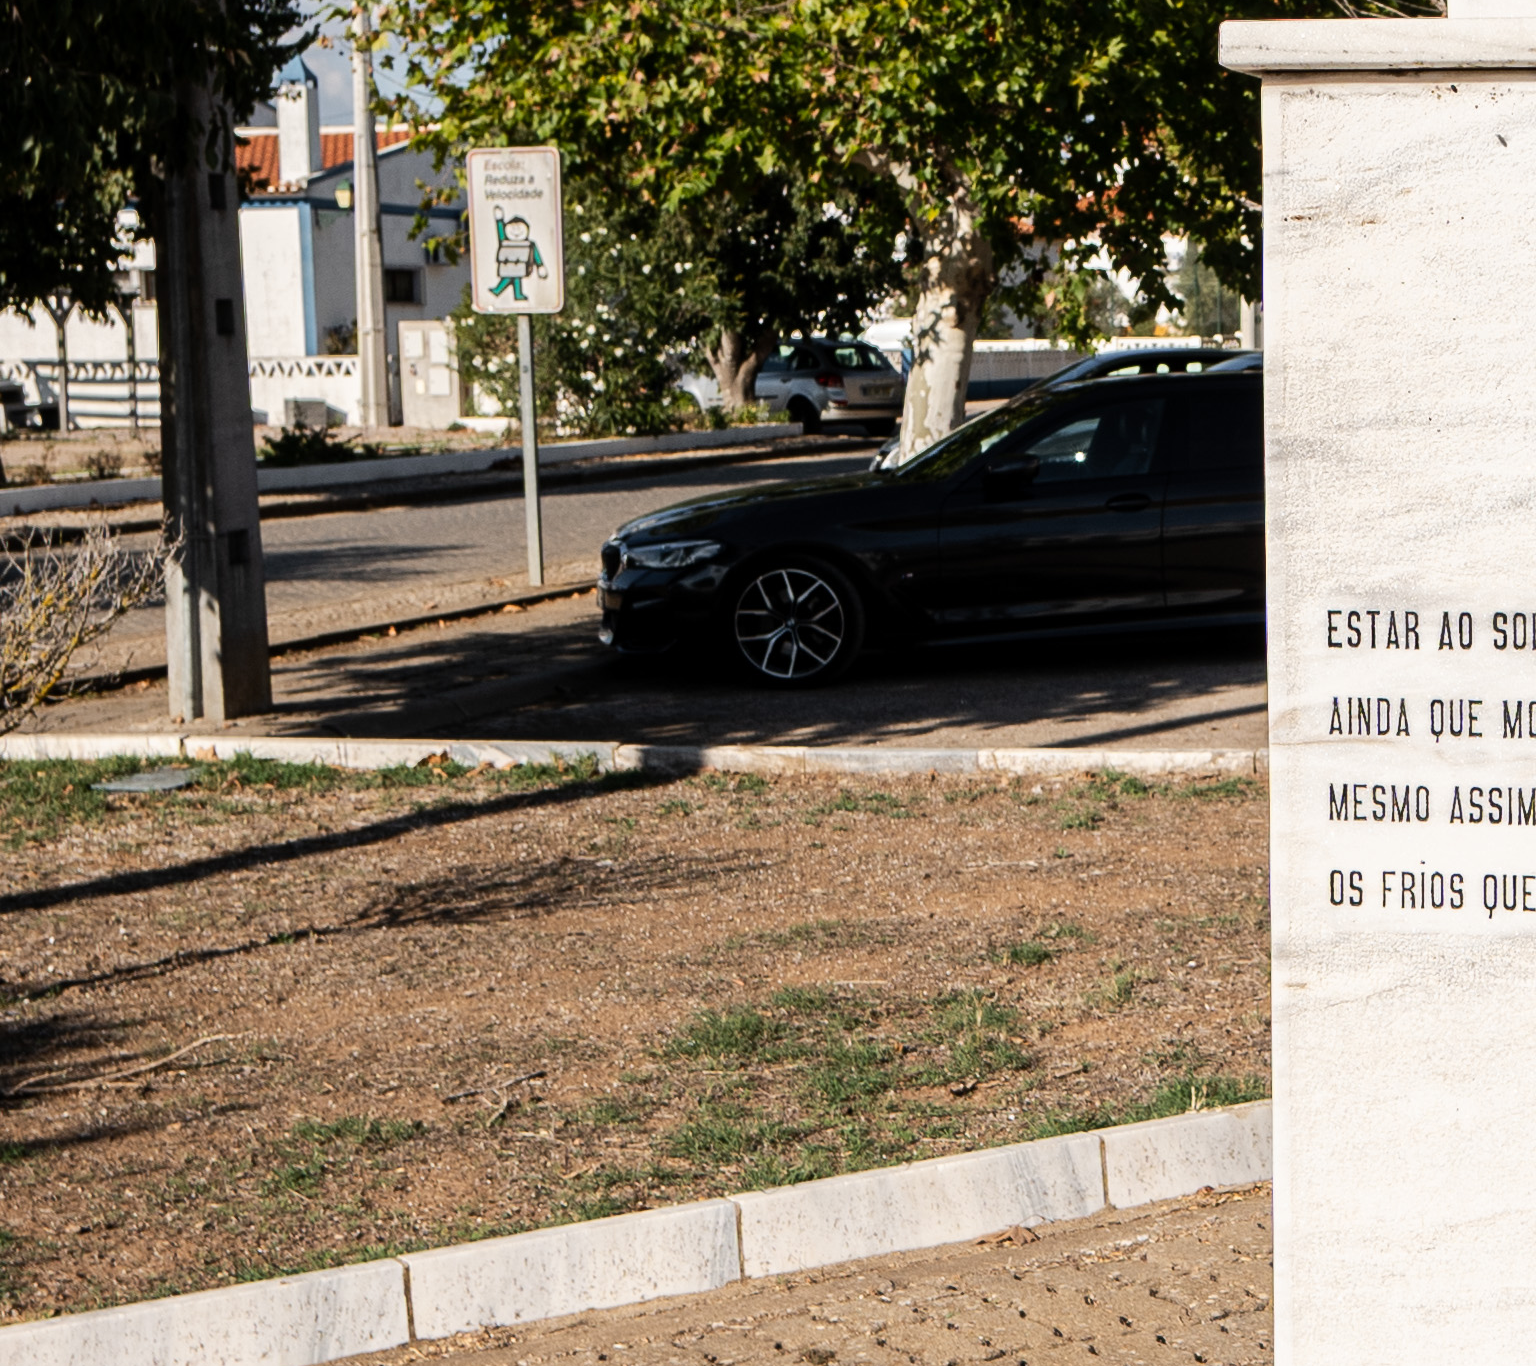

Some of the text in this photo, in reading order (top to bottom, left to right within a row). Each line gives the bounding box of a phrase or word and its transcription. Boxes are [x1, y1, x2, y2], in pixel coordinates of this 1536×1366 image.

[484, 188, 543, 200] Velocidade
[1326, 609, 1420, 650] ESTAR
[1437, 611, 1473, 651] AO
[1328, 696, 1411, 737] AINDA
[1429, 698, 1483, 744] QUE
[1328, 782, 1430, 823] MESMO
[1449, 785, 1536, 827] ASSIM
[1329, 869, 1364, 907] OS
[1483, 873, 1536, 920] QUE
